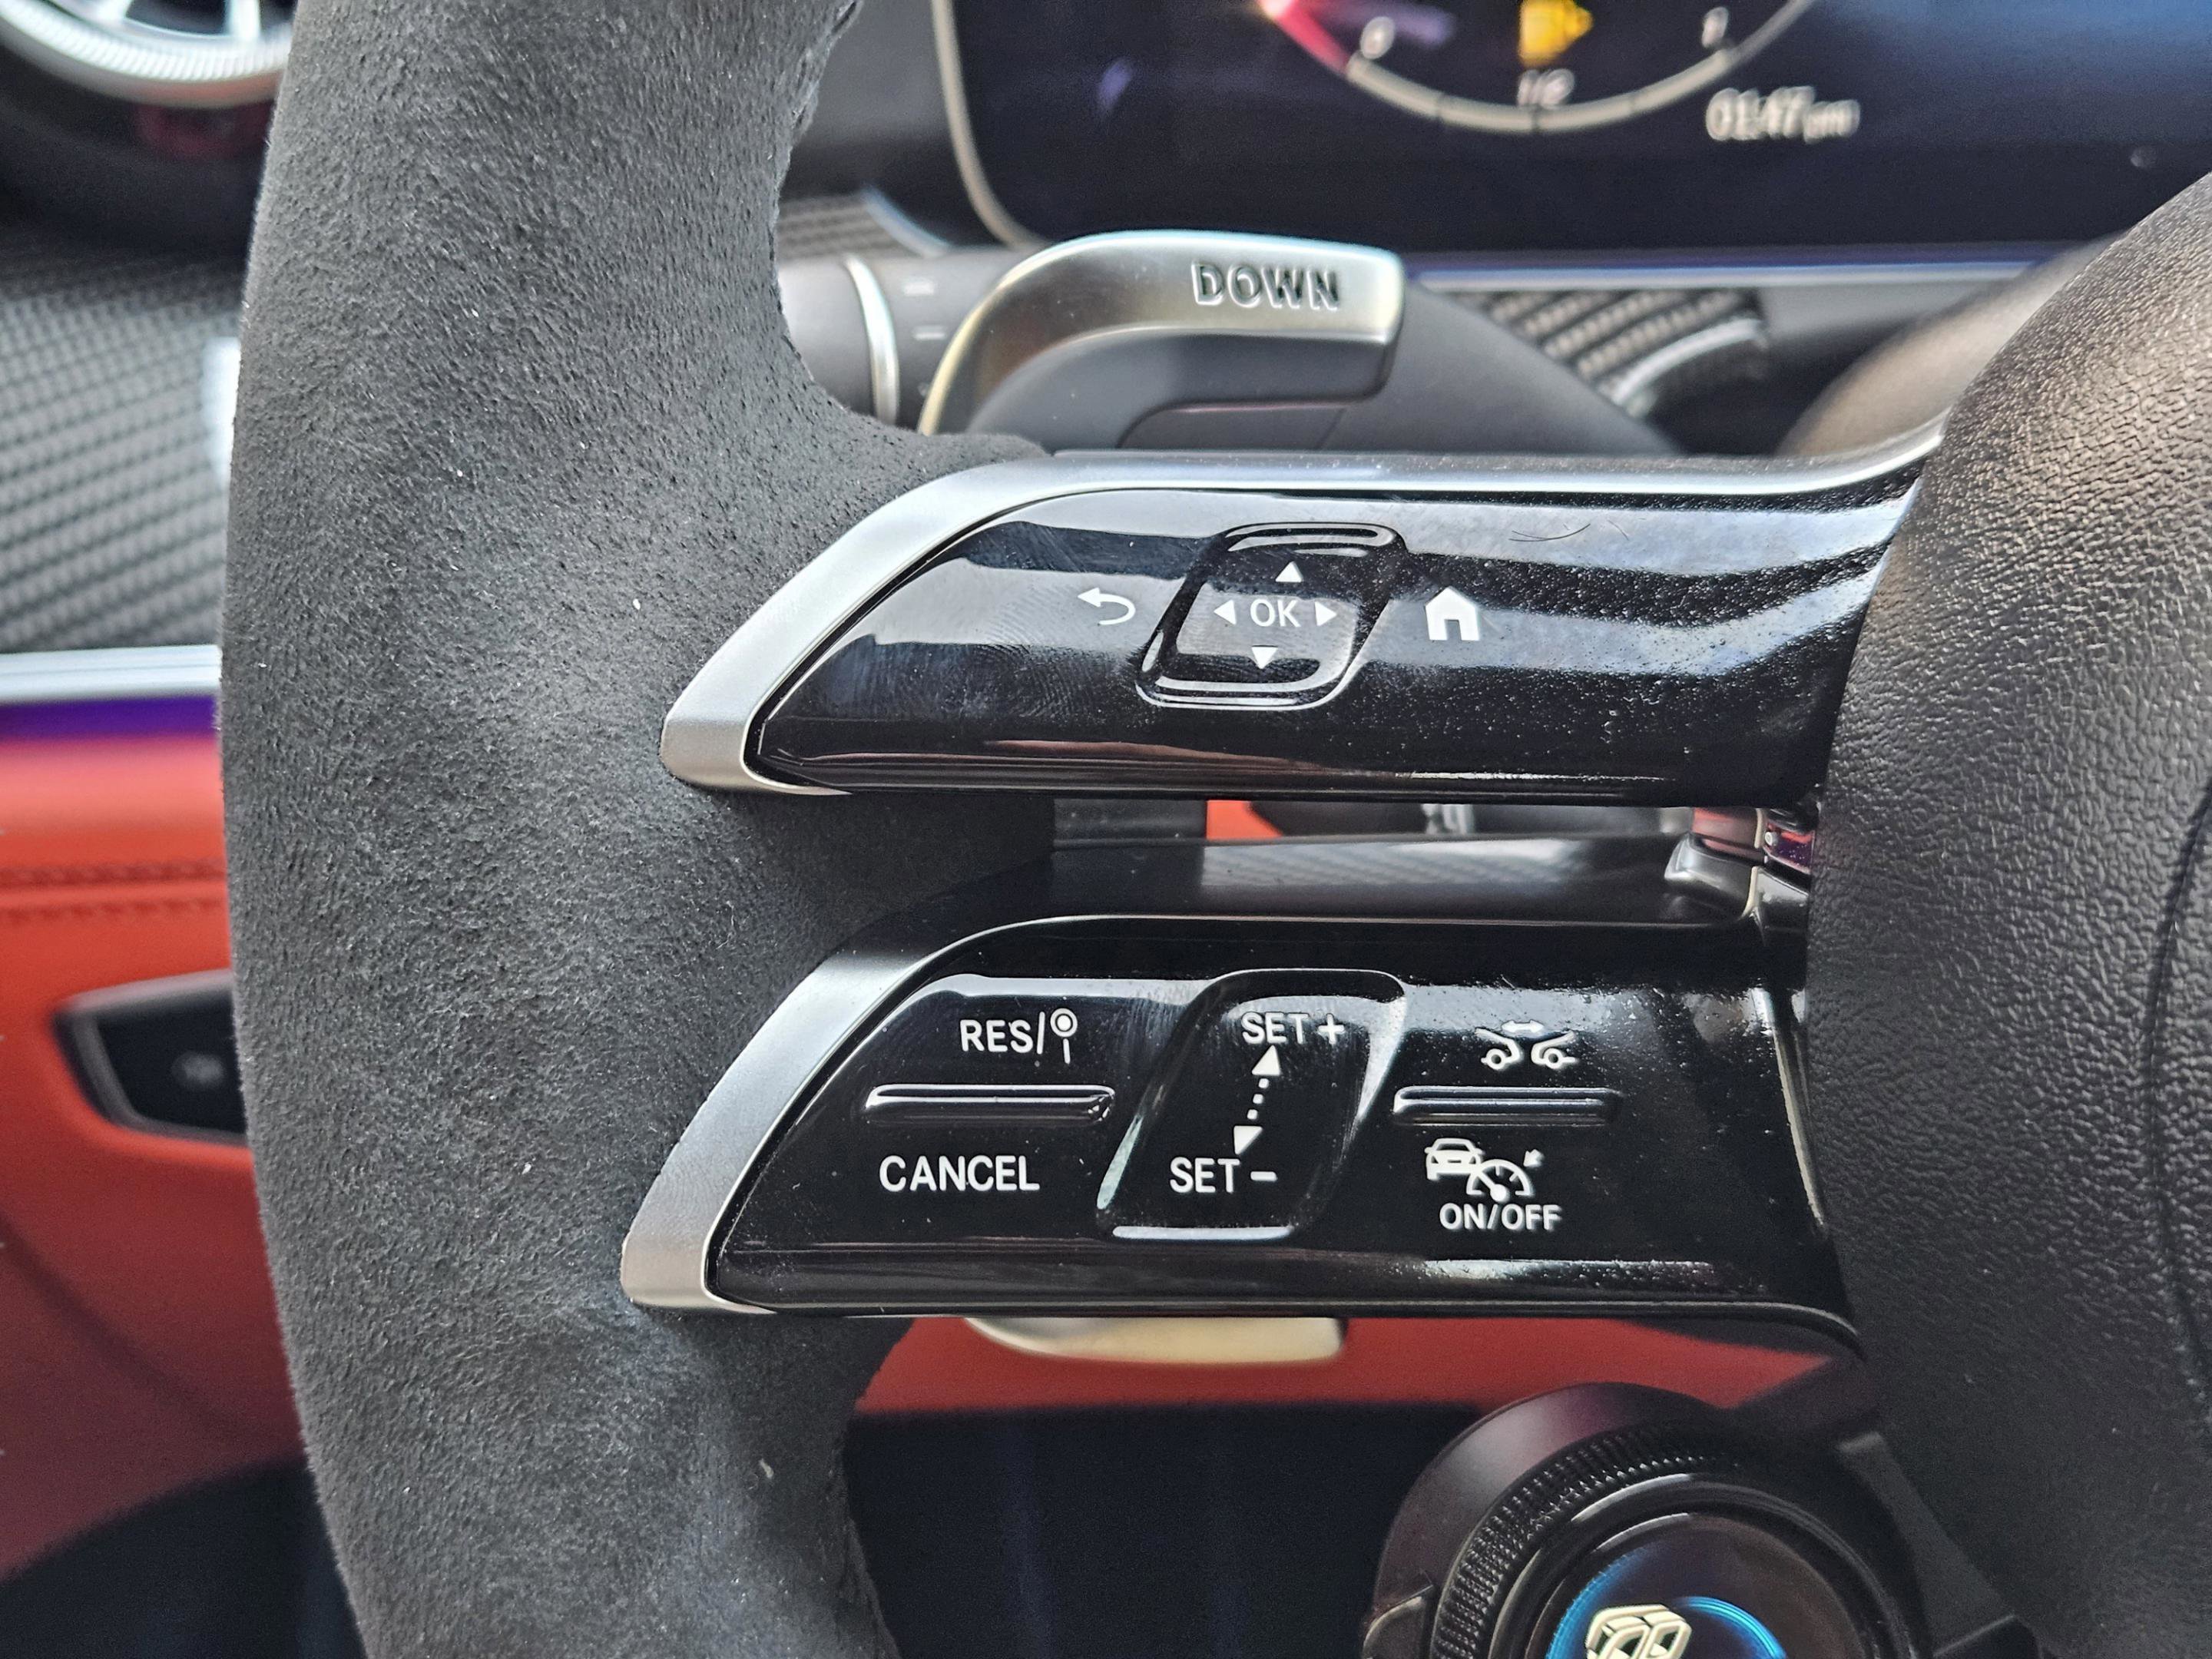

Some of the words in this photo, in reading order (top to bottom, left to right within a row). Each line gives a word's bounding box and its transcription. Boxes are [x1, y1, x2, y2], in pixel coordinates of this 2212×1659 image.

[1190, 261, 1340, 311] DOWN
[1249, 598, 1301, 628] OK
[879, 1154, 1040, 1192] CANCEL
[1439, 1202, 1562, 1230] ON/OFF
